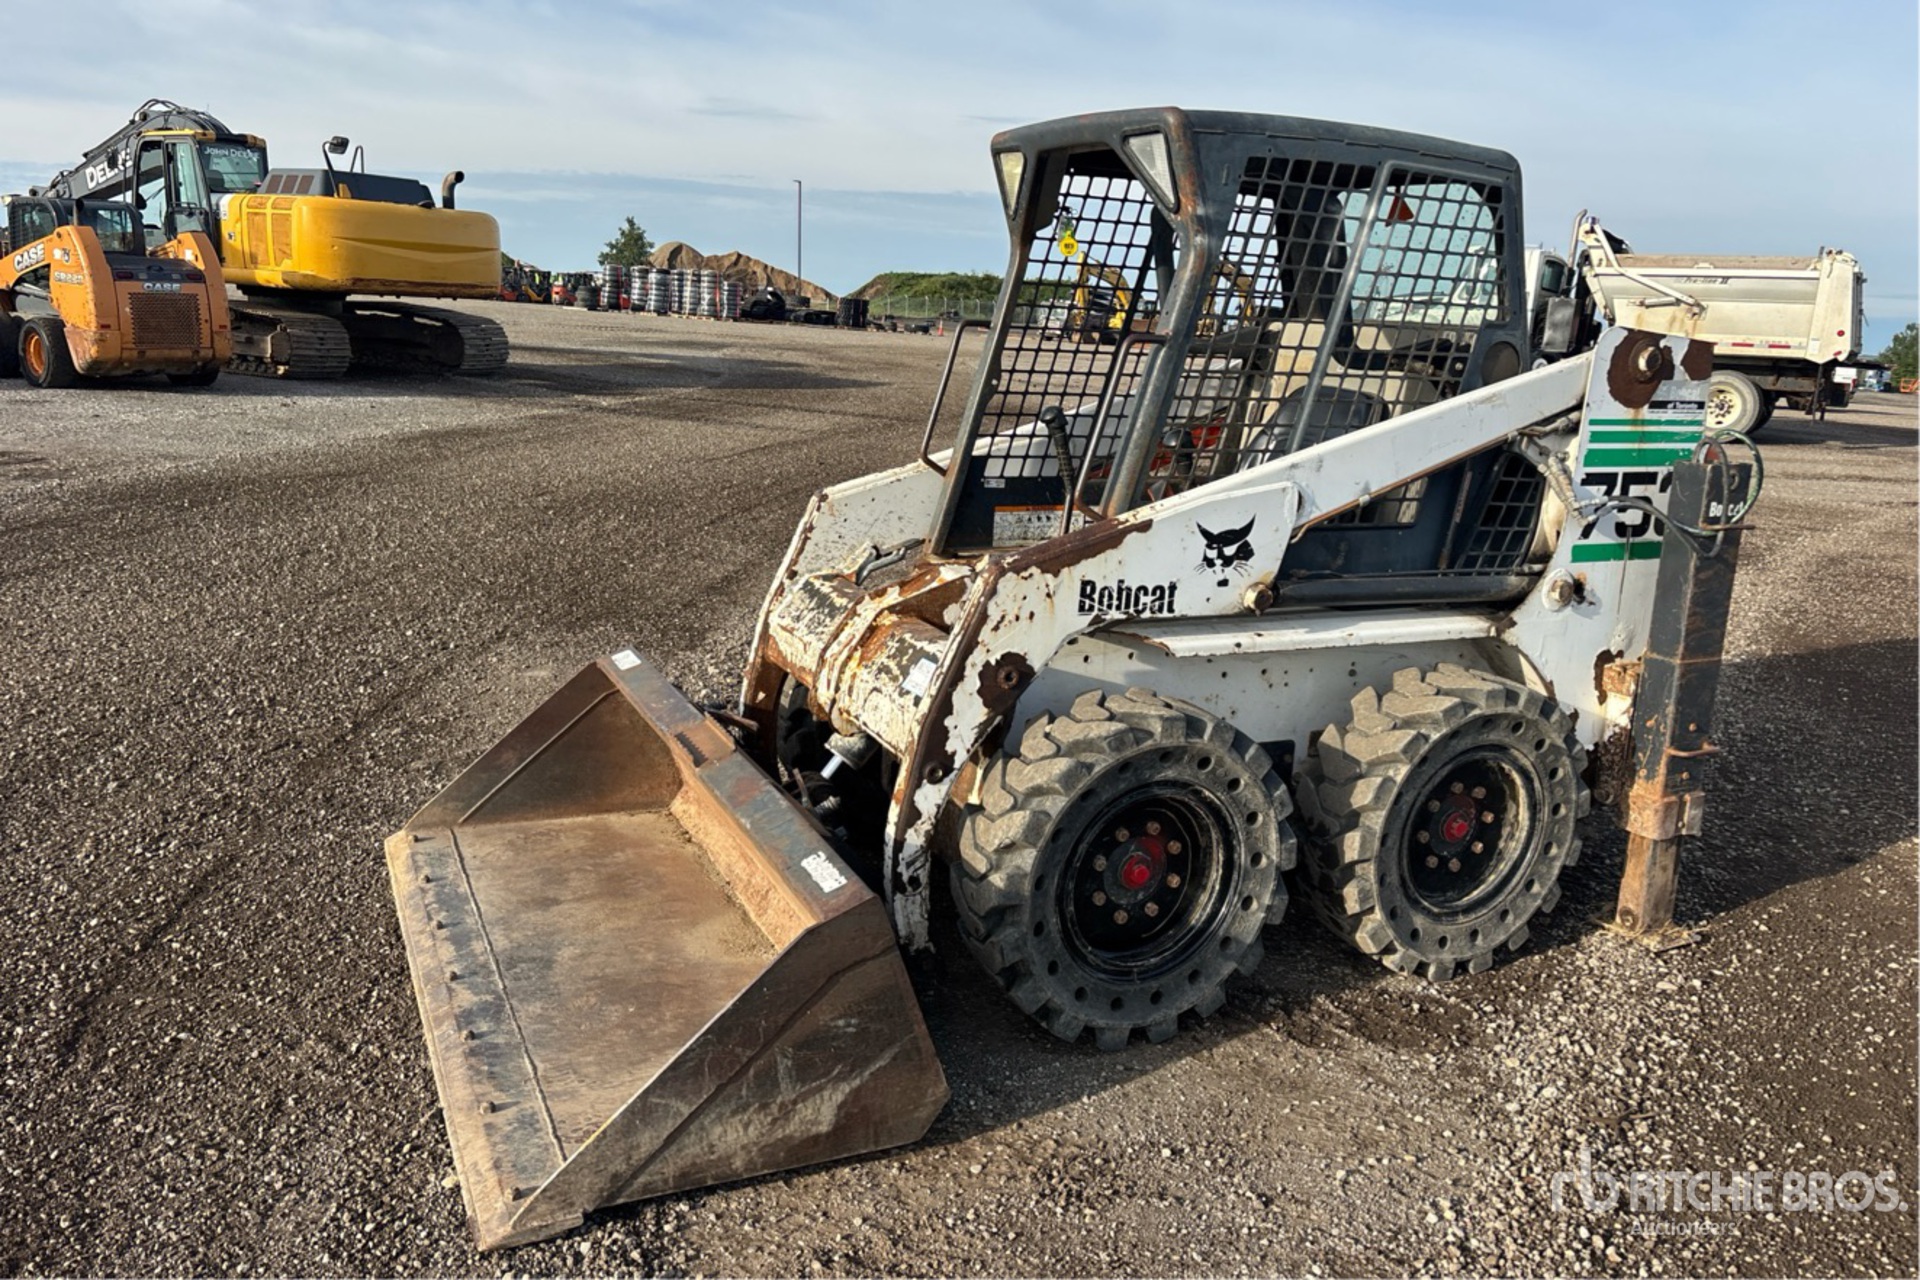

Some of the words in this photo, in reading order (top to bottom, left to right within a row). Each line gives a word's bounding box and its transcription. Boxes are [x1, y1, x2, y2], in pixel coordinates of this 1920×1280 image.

[204, 146, 229, 156] JOHN
[14, 243, 46, 272] CASE
[143, 282, 182, 292] CASE
[1078, 579, 1177, 616] Bobcat
